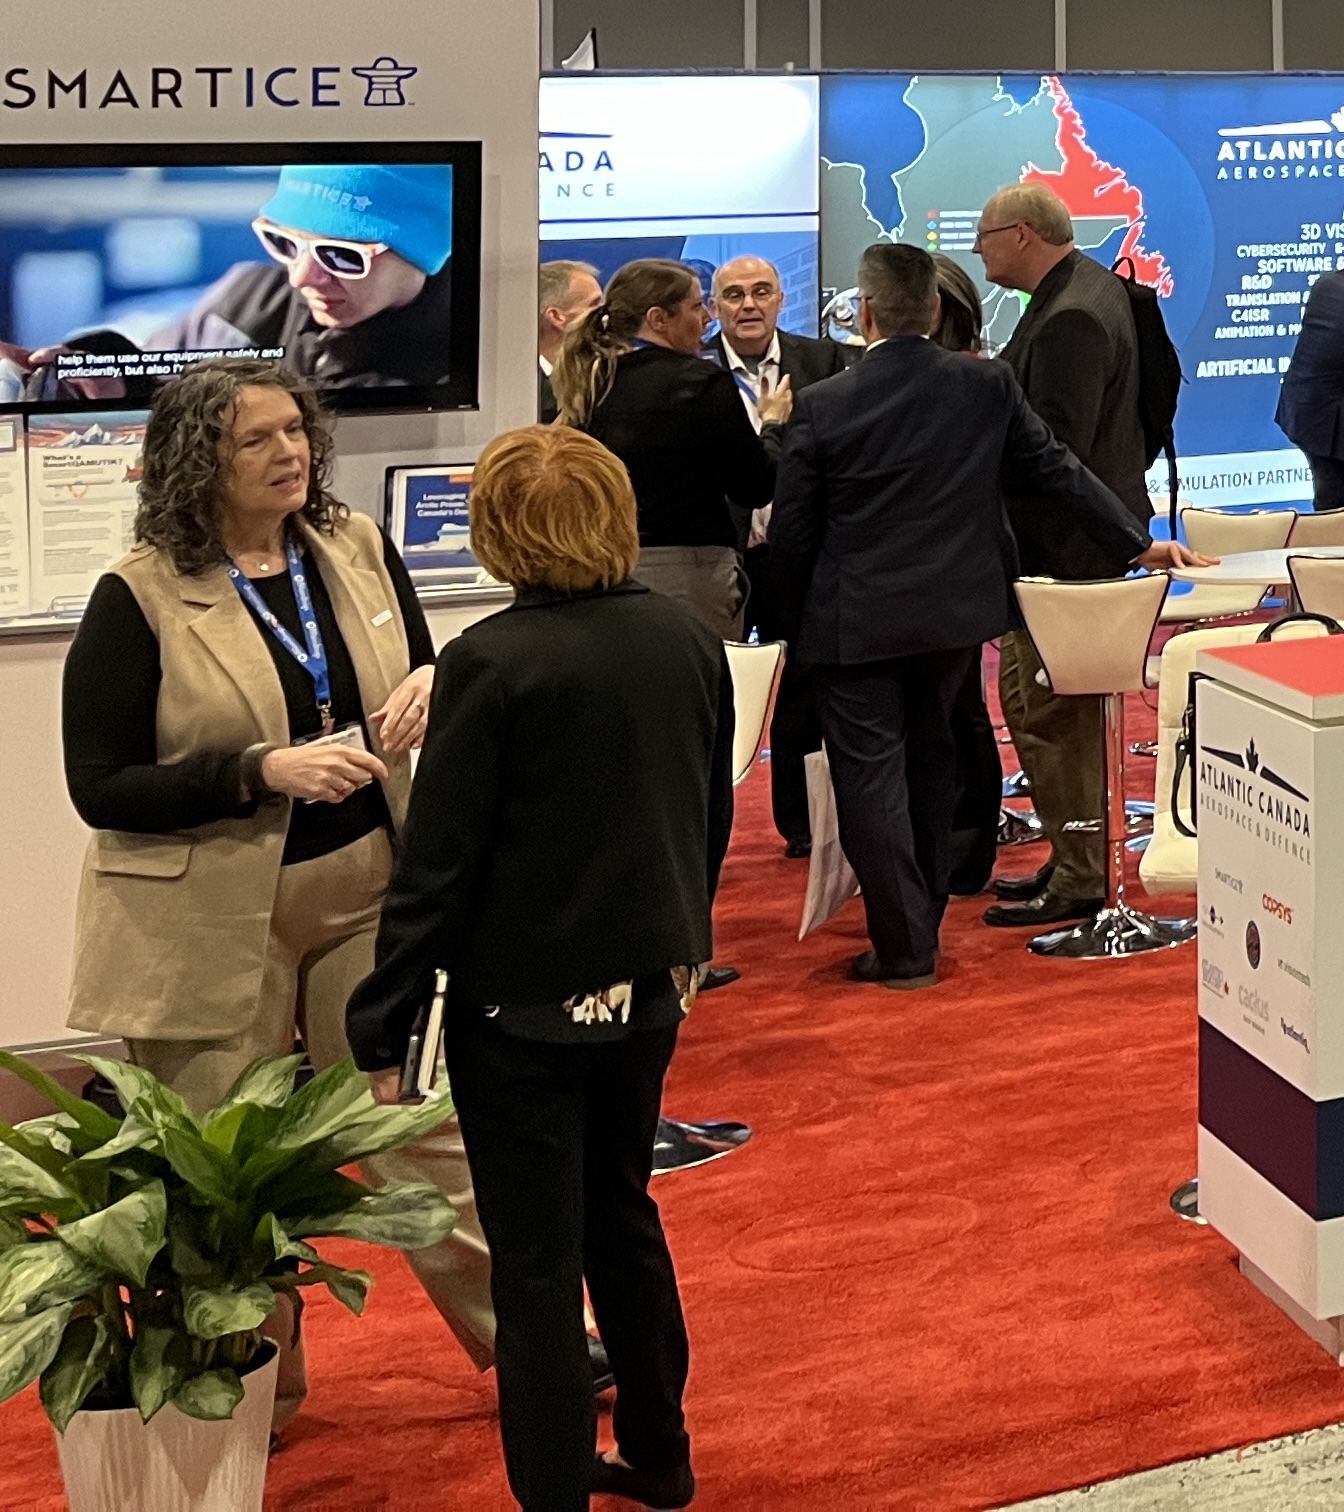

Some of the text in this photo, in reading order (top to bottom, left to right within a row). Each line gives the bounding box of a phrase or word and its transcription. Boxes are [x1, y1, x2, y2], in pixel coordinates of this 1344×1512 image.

[2, 67, 342, 110] SMARTICE
[1301, 224, 1320, 240] 3D
[1237, 243, 1326, 258] CYBERSECURITY
[1257, 257, 1333, 274] SOFTWARE
[1241, 275, 1272, 290] R&D
[1226, 291, 1301, 307] TRANSLATION
[1231, 309, 1270, 323] C4ISR
[1215, 325, 1274, 339] ANIMATION
[1276, 324, 1286, 337] &
[57, 347, 283, 366] help them use our equipment safely and
[57, 366, 122, 379] proficiently,
[124, 365, 144, 376] but
[146, 364, 170, 375] also
[1197, 357, 1276, 378] ARTIFICIAL
[1149, 479, 1161, 494] &
[1200, 761, 1311, 839] ATLANTIC CANADA
[1200, 792, 1252, 833] AEROSPACE
[1264, 827, 1311, 866] DEFENCE
[1262, 893, 1292, 925] COPSYS
